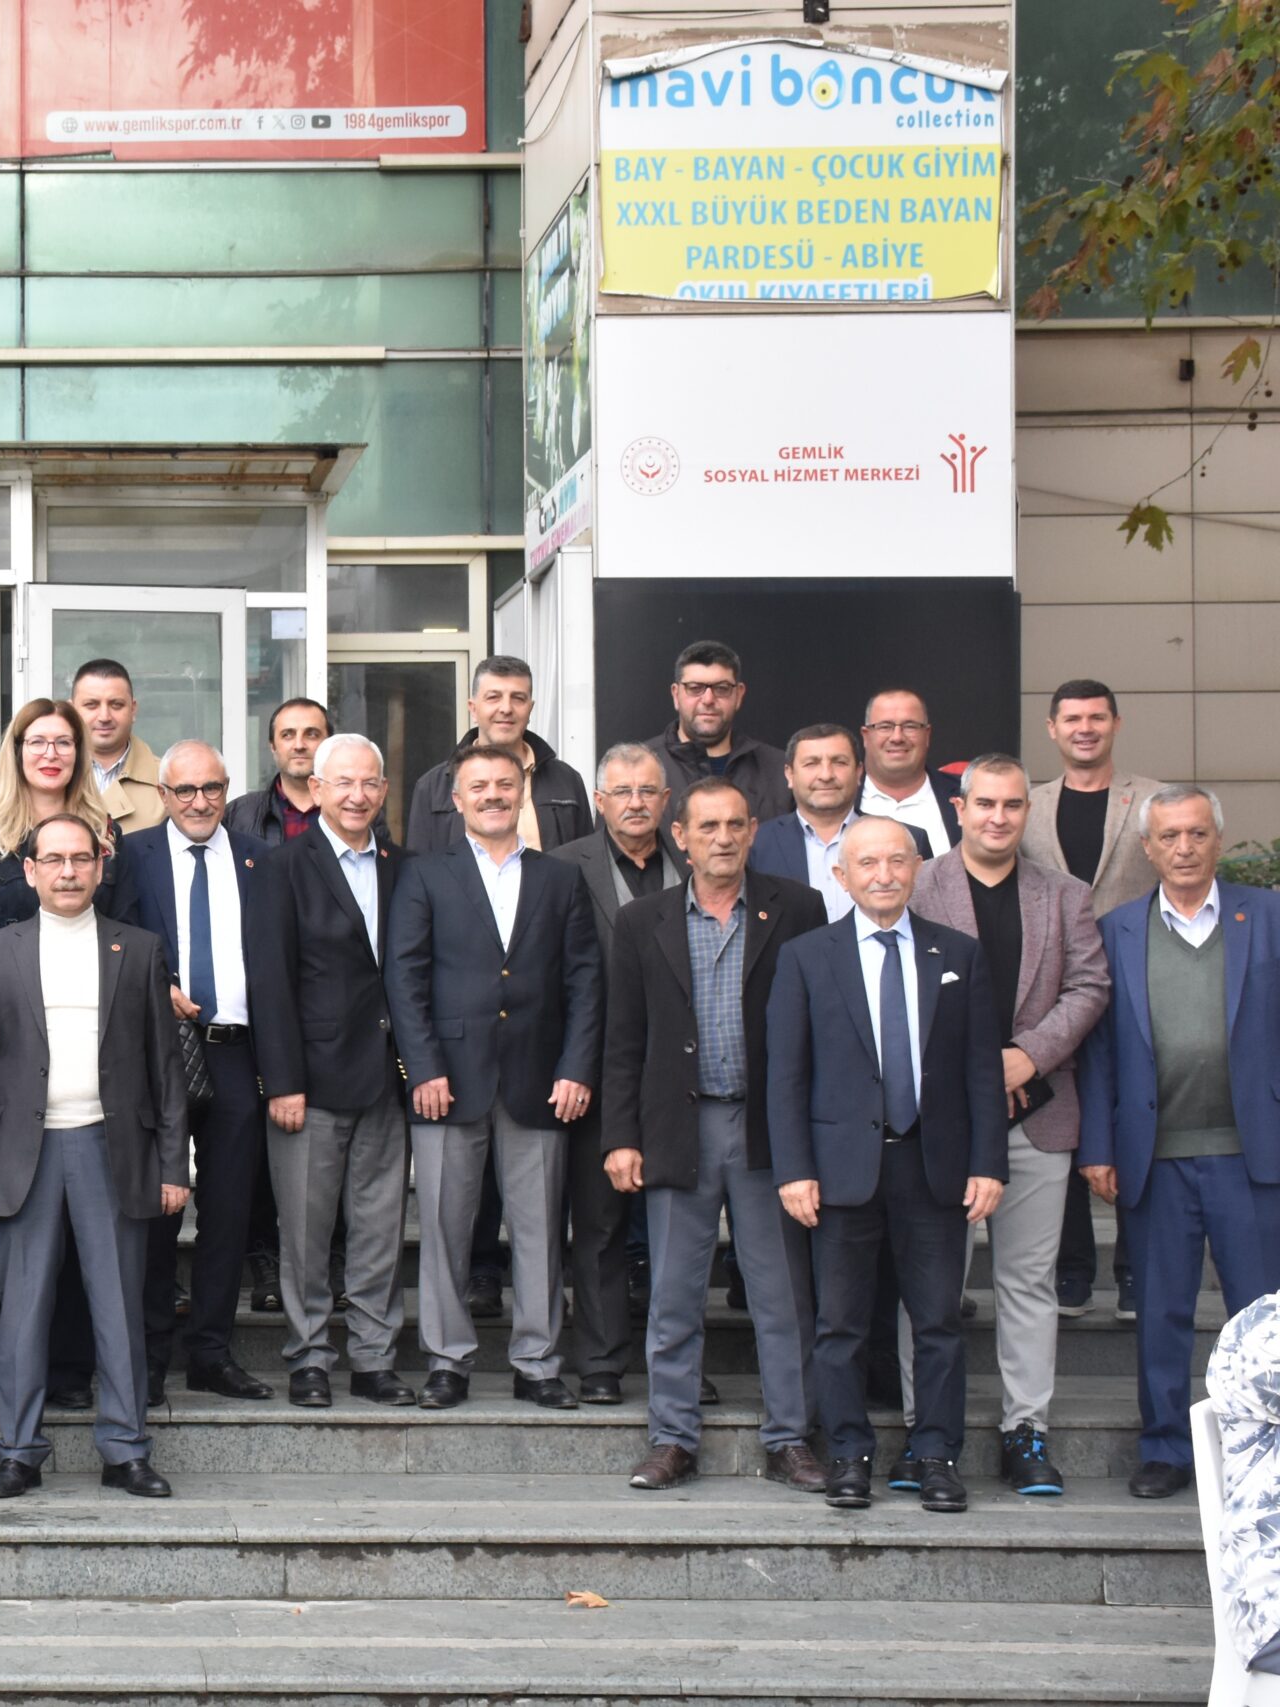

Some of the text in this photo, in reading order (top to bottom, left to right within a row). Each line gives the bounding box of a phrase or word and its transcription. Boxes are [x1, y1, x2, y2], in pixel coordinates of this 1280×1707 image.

[611, 54, 751, 108] mavi
[84, 112, 450, 134] www.gemlikspor.com.tr 1984gemlikspor
[896, 108, 995, 129] collection
[614, 157, 667, 182] BAY
[693, 155, 785, 181] BAYAN
[811, 153, 905, 187] ÇOCUK
[913, 146, 996, 178] GİYİM
[617, 194, 992, 226] XXXL BÜYÜK BEDEN BAYAN
[686, 239, 814, 270] PARDESÜ
[841, 237, 924, 268] ABİYE
[778, 443, 844, 460] GEMLİK
[703, 464, 920, 483] SOSYAL HİZMET MERKEZİ
